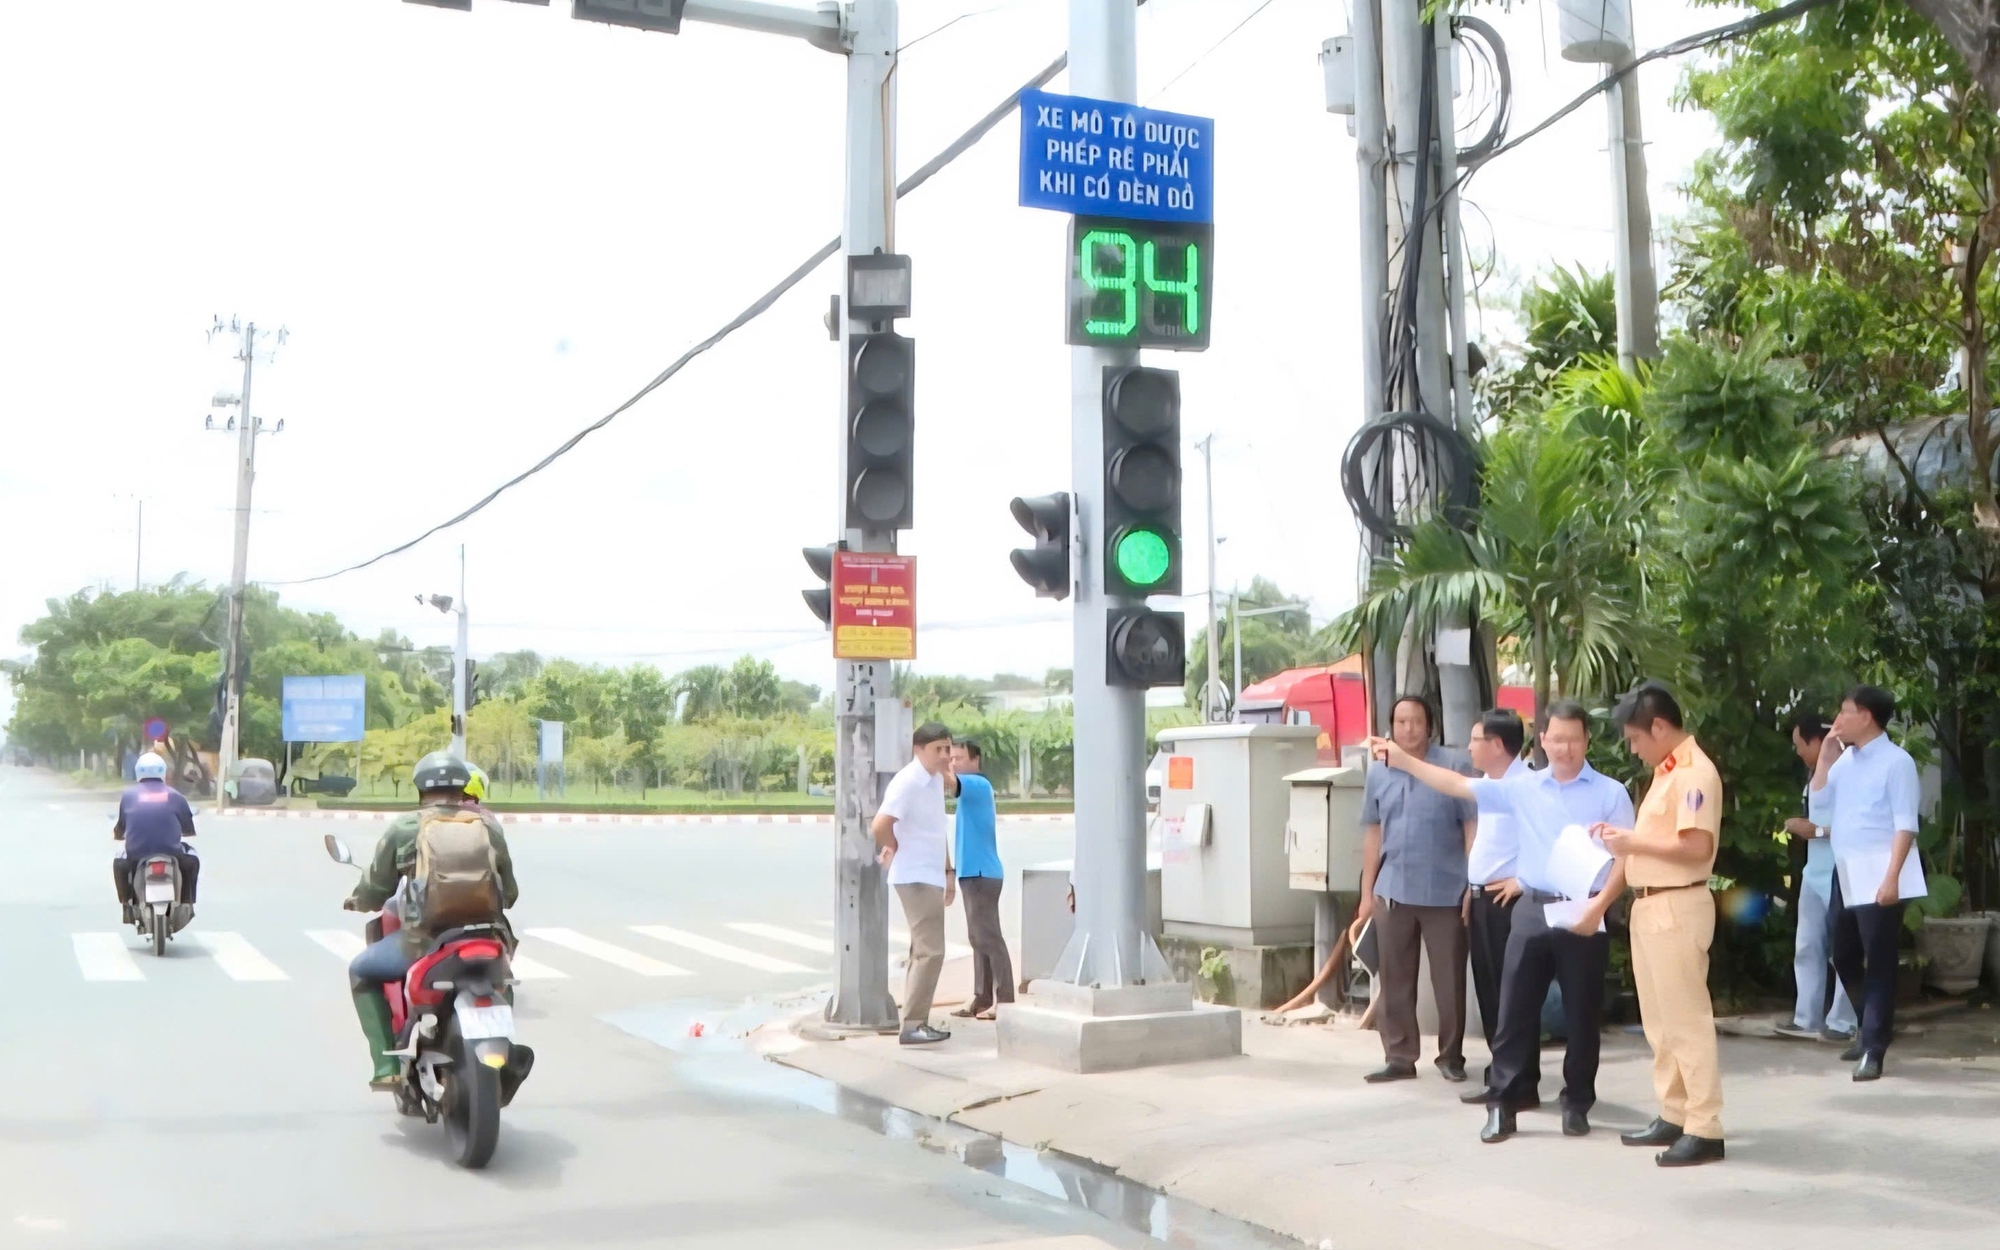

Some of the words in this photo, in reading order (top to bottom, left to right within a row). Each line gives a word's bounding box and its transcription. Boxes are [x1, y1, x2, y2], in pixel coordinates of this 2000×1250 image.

[1037, 105, 1063, 130] XE
[1071, 109, 1103, 135] MÔ
[1111, 113, 1136, 139] TÔ
[1047, 138, 1101, 166] PHÉP
[1143, 150, 1189, 179] PHẢI
[1040, 169, 1075, 196] KHI
[1084, 171, 1110, 200] CÓ
[1081, 230, 1198, 336] 94
